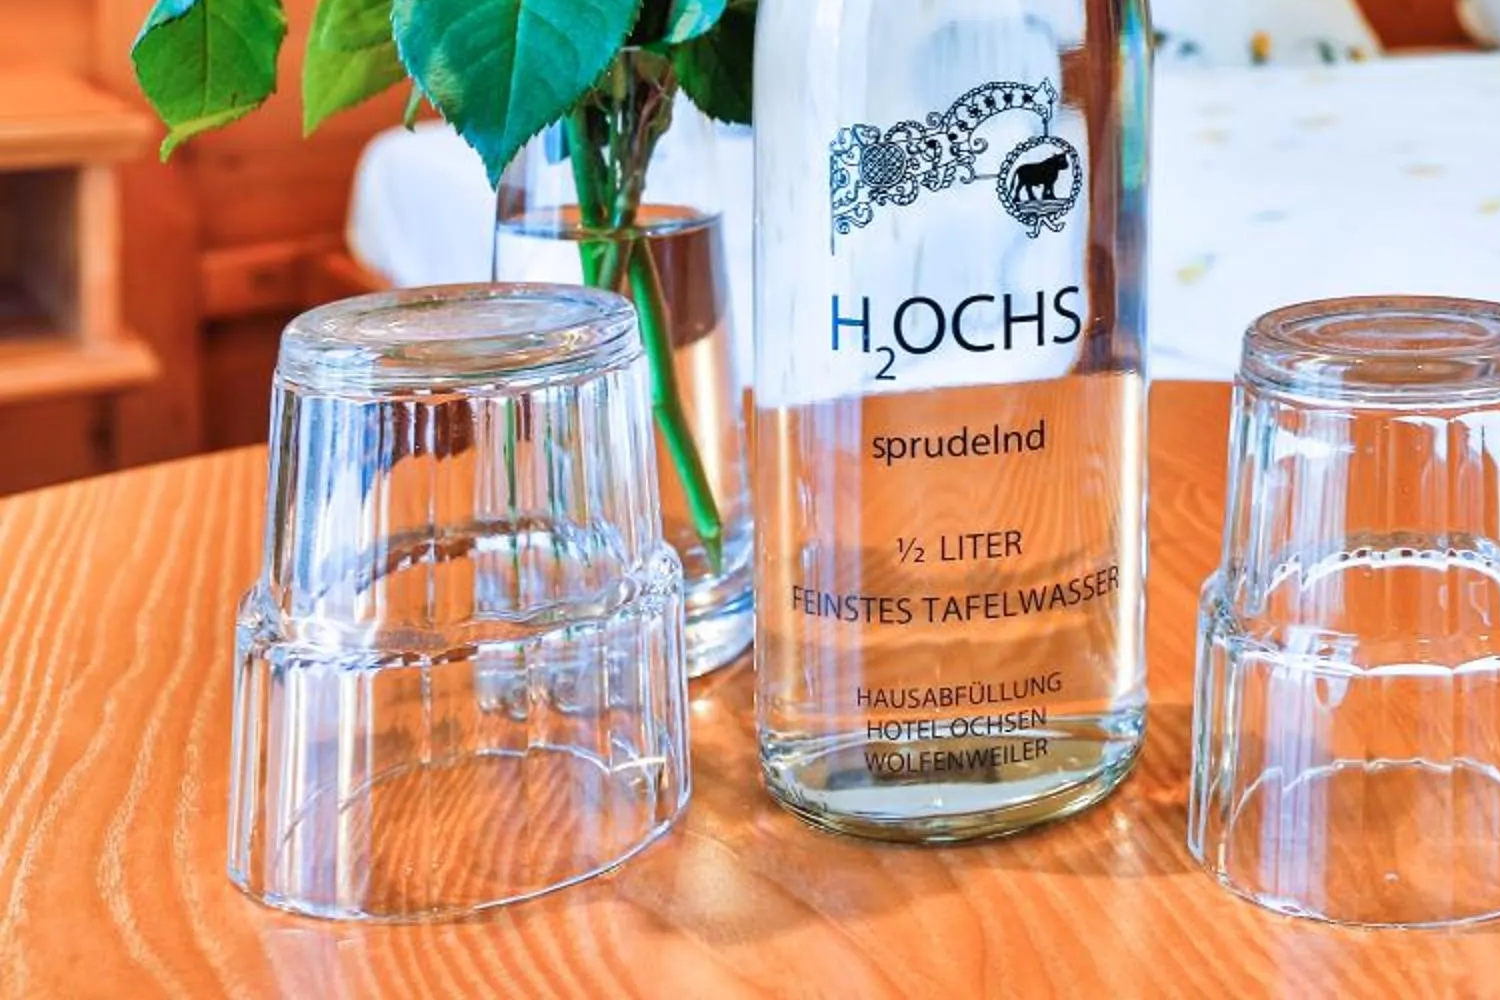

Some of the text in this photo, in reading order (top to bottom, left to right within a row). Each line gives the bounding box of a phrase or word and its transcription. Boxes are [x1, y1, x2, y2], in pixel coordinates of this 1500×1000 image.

[872, 420, 1046, 466] sprudelnd
[940, 530, 1024, 562] LITER
[792, 564, 1120, 625] FEINSTES TAFELWASSER
[856, 671, 1063, 710] HAUSABFÜLLUNG
[866, 708, 1048, 742] HOTEL OCHSEN
[863, 739, 1049, 774] WOLFENWEILER
